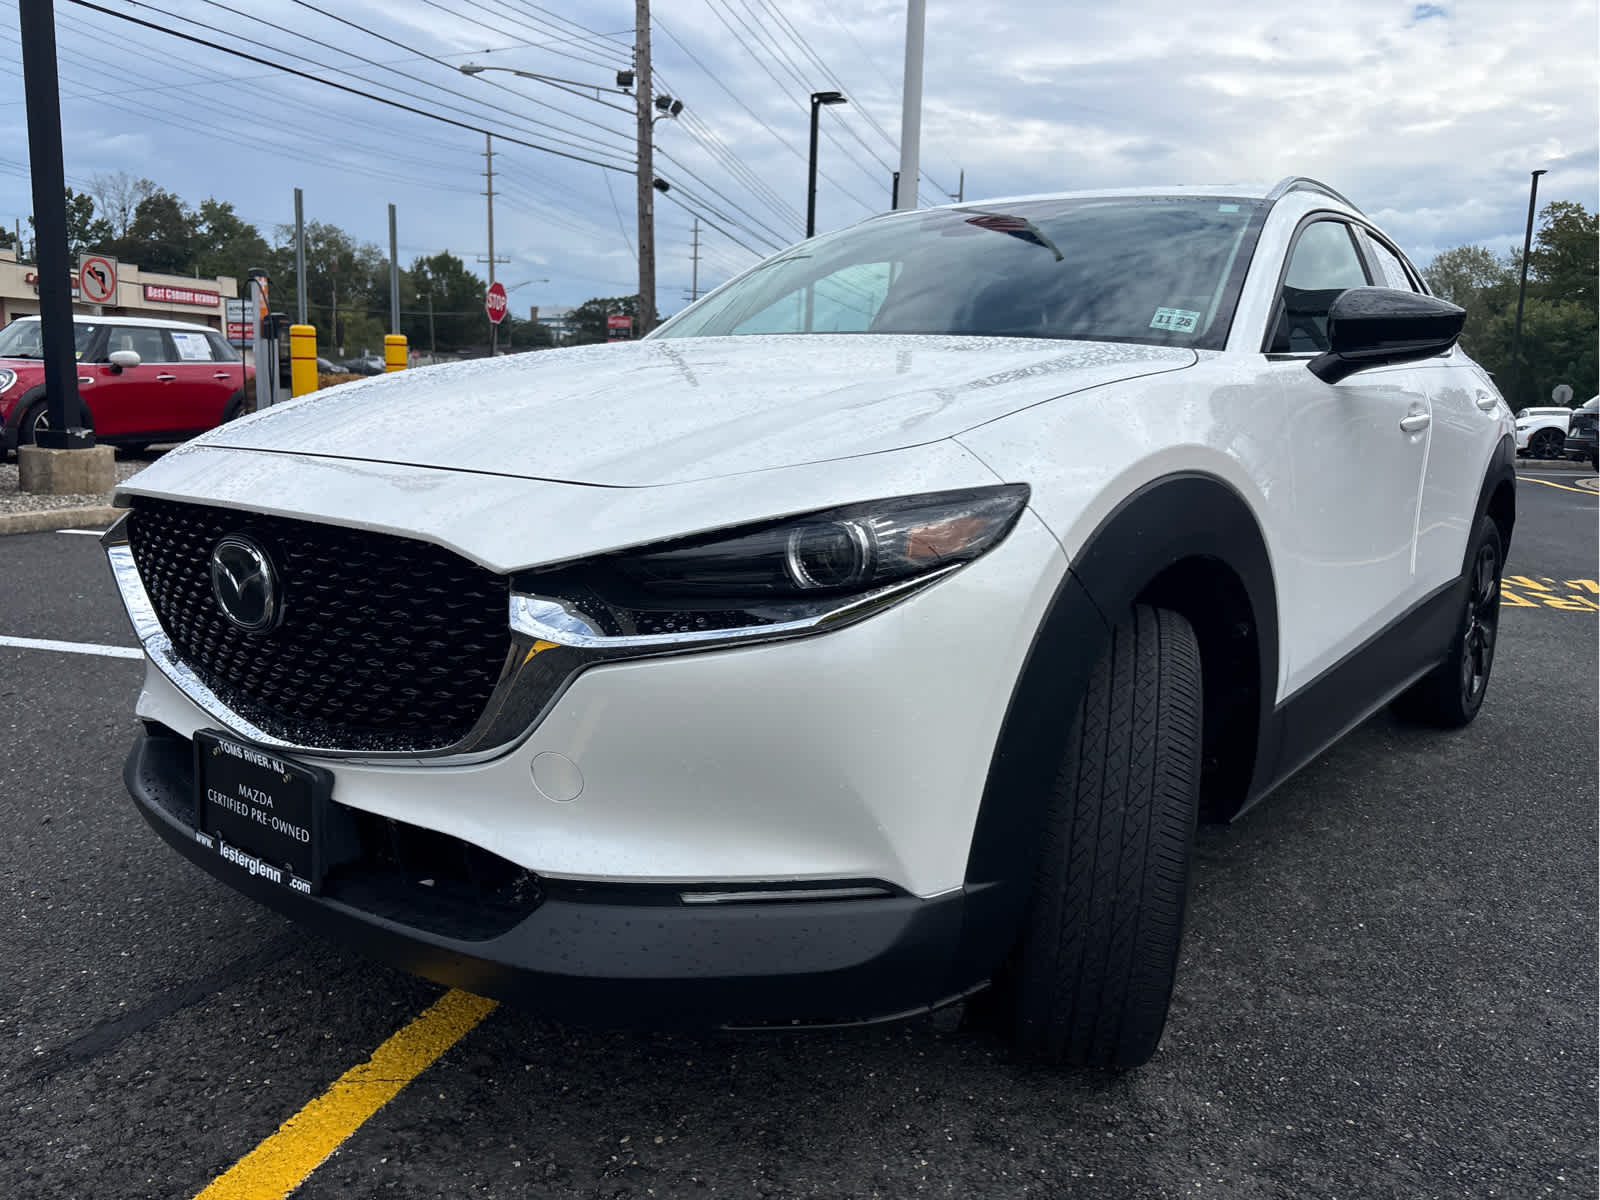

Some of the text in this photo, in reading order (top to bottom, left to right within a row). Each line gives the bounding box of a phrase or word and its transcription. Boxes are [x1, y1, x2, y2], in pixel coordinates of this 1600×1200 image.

[487, 293, 506, 311] STOP
[1155, 314, 1193, 327] 11 28
[218, 740, 243, 759] TOMS
[272, 760, 285, 774] NJ
[238, 783, 274, 809] MAZDA
[207, 788, 310, 843] CERTIFIED PRE-OWNED
[195, 831, 311, 895] www. lesterglenn .com
